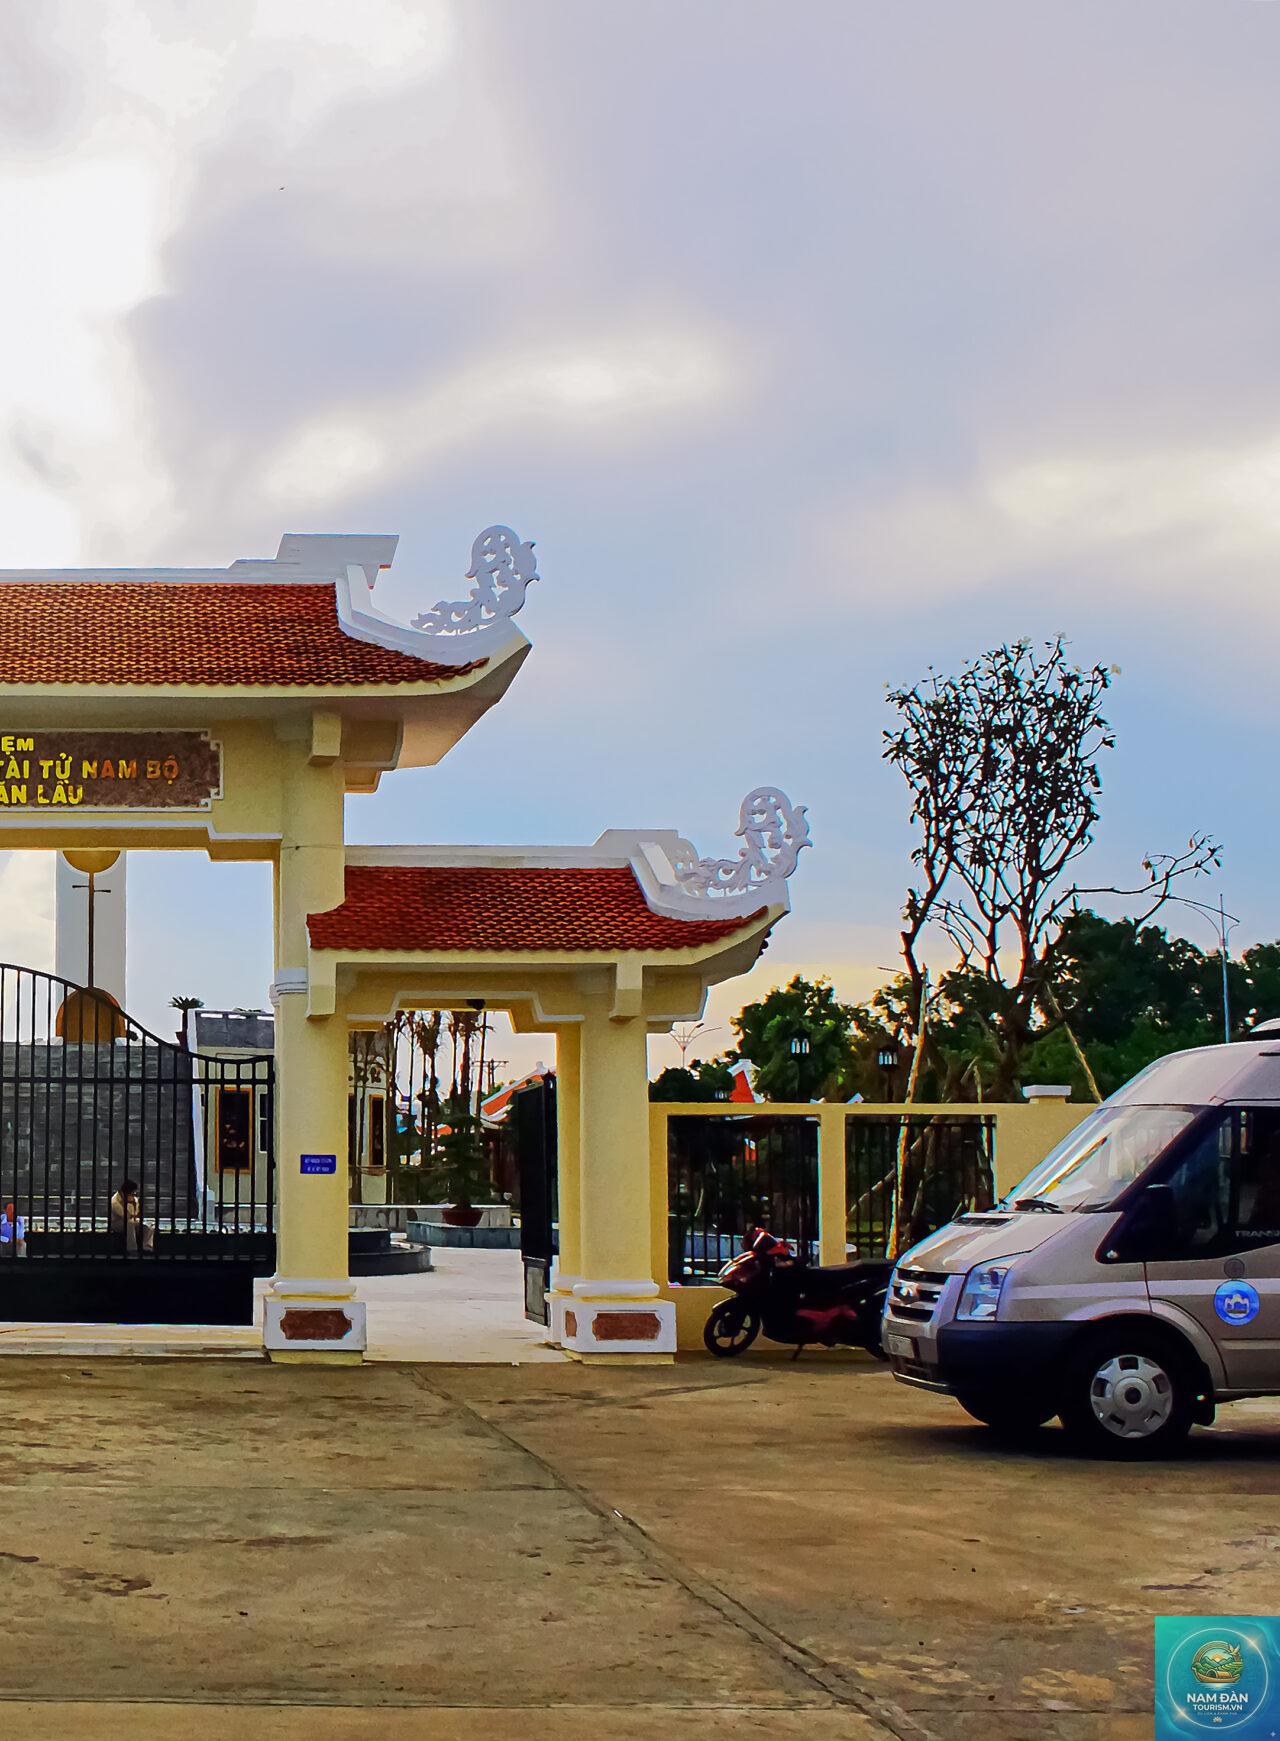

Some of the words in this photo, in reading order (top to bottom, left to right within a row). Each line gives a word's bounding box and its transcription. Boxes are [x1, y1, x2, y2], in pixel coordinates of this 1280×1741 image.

[39, 752, 73, 780] TỬ
[81, 758, 138, 780] NAM
[146, 755, 180, 785] BỘ
